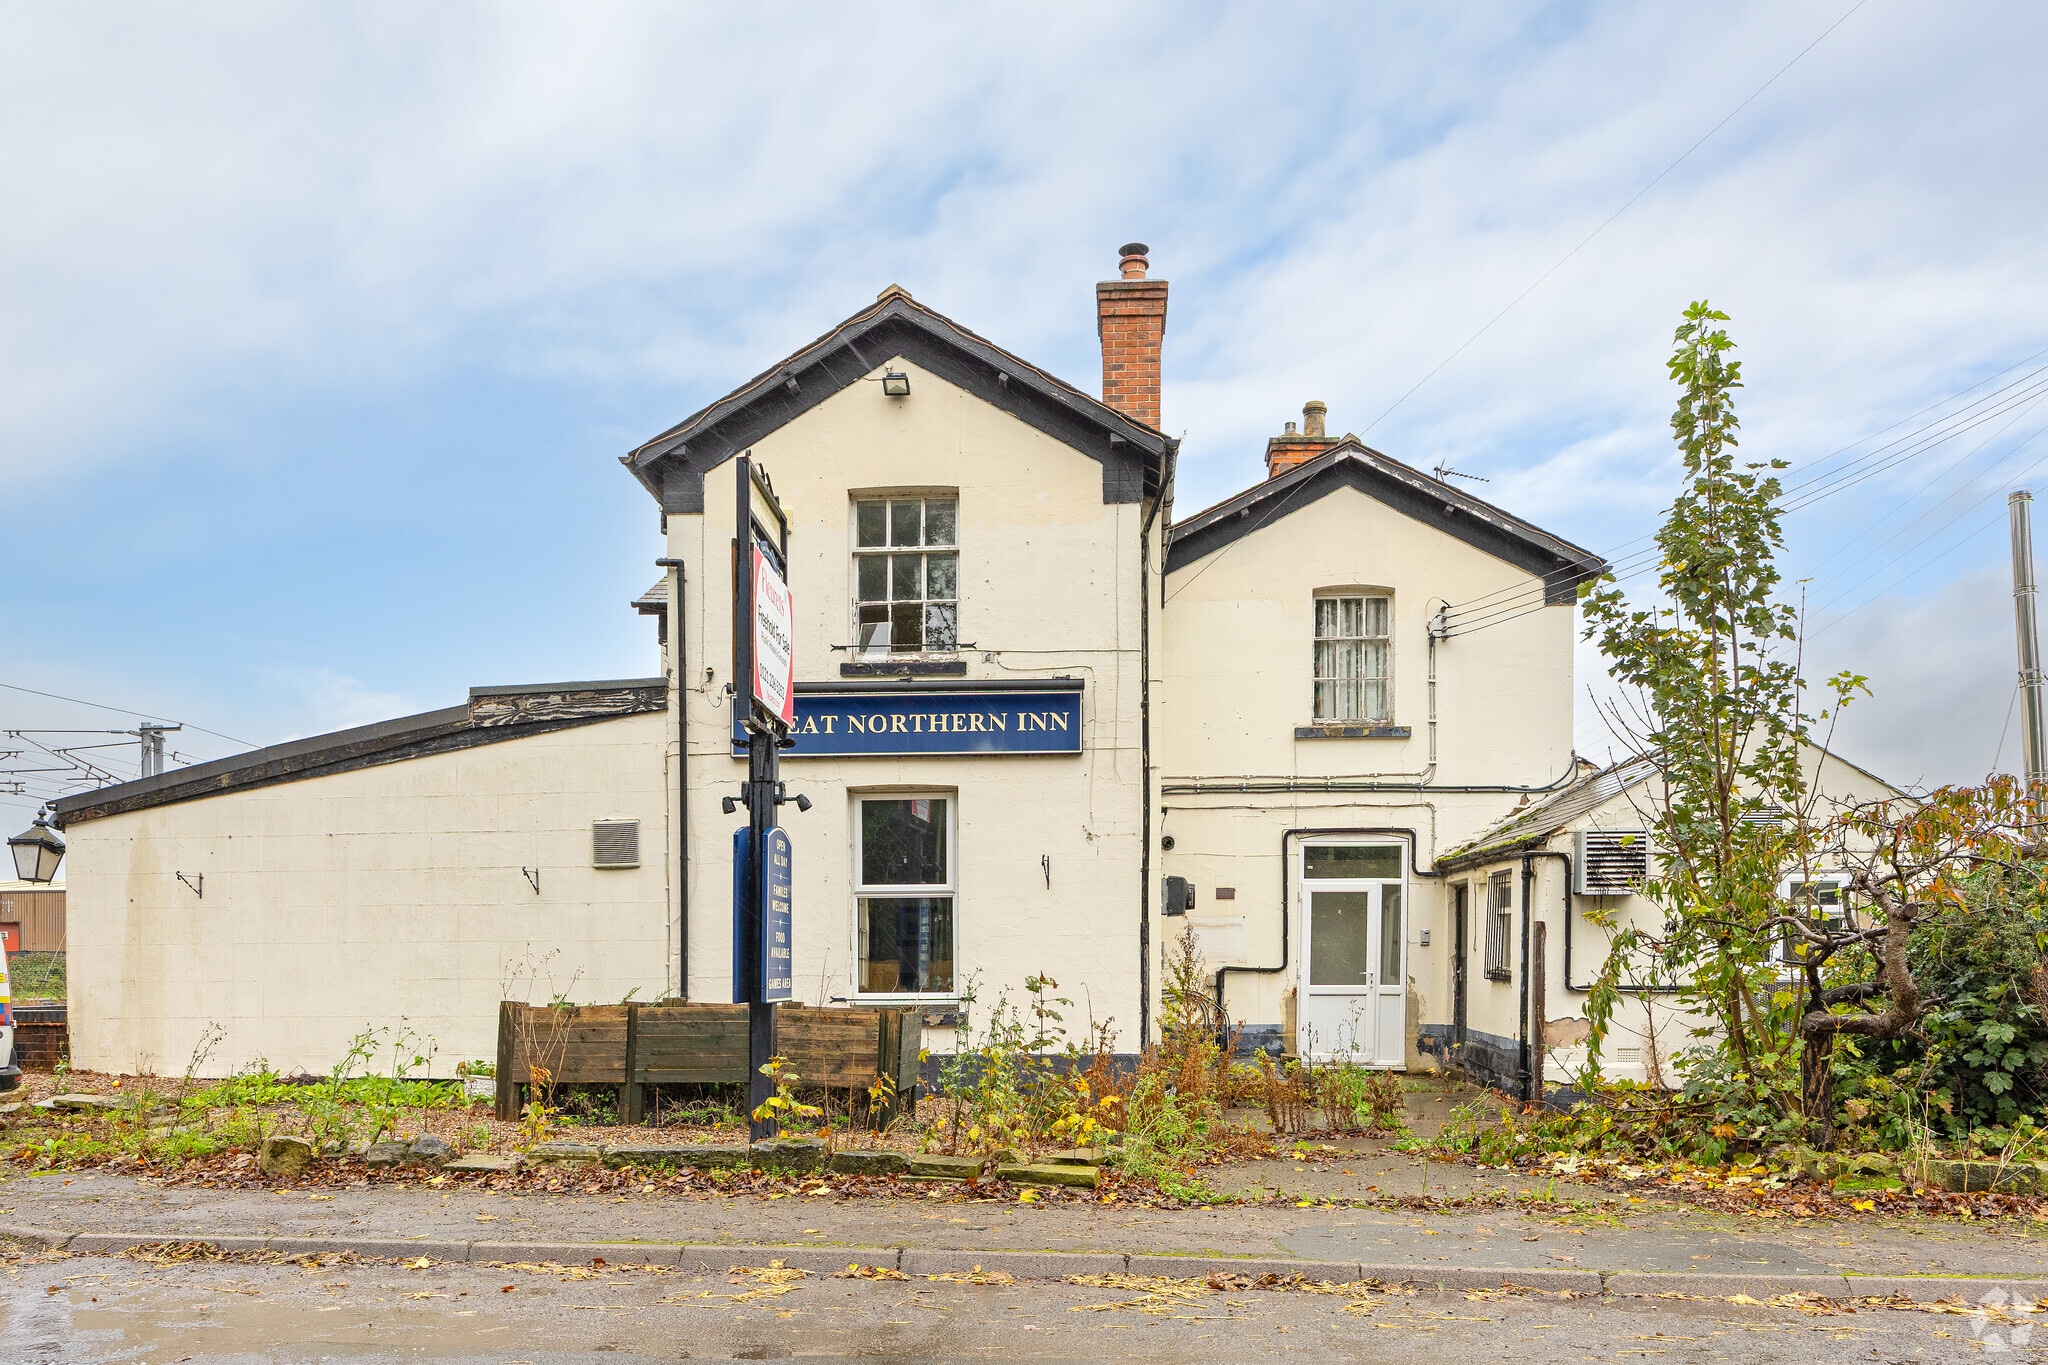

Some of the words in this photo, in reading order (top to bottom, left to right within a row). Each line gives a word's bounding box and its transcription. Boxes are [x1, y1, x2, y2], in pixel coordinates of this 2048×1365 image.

[758, 604, 776, 638] Freehold
[782, 633, 790, 656] Sale
[744, 715, 838, 734] EAT
[847, 713, 1007, 734] NORTHERN
[1017, 711, 1070, 732] INN
[776, 839, 786, 852] OPEN
[774, 884, 788, 898] FAMILIES
[772, 900, 789, 914] WELCOME
[775, 931, 786, 943] FOOD
[770, 946, 790, 959] AVAILABLE
[768, 978, 782, 990] GAMES
[782, 977, 791, 989] AREA
